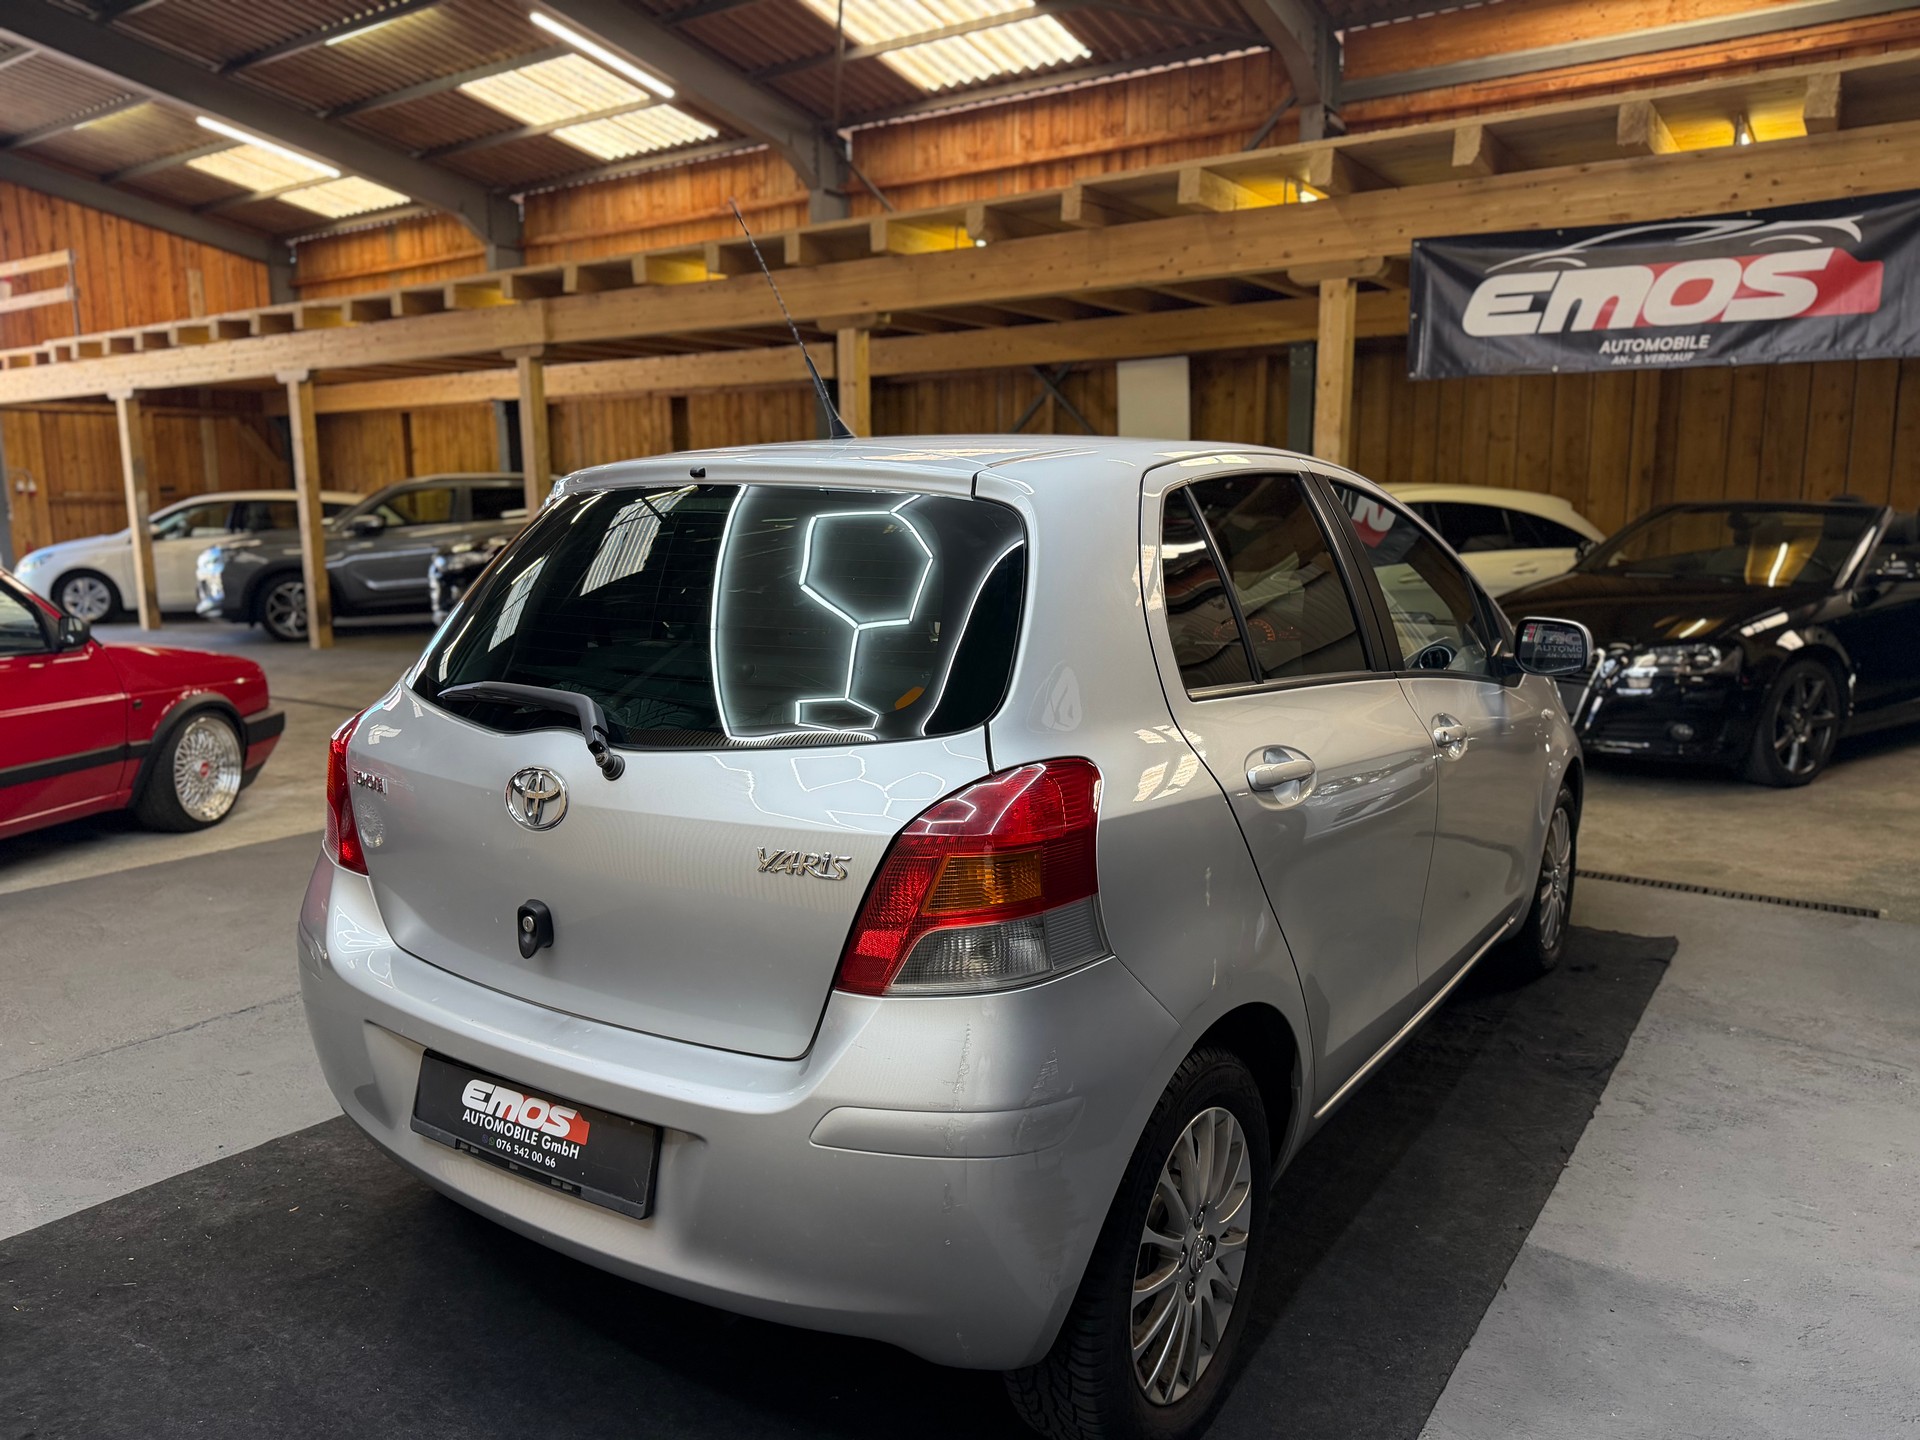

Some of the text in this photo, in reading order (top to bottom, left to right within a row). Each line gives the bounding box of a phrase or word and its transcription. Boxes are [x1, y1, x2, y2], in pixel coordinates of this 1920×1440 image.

[1462, 247, 1836, 336] EMOS
[1598, 335, 1711, 354] AUTOMOBILE
[1611, 352, 1695, 365] AN- & VERKAUF
[351, 768, 388, 795] TOYOTA
[462, 1079, 578, 1138] EMOS
[462, 1109, 580, 1160] AUTOMOBILE GmbH
[496, 1138, 556, 1168] 076 542 00 66
